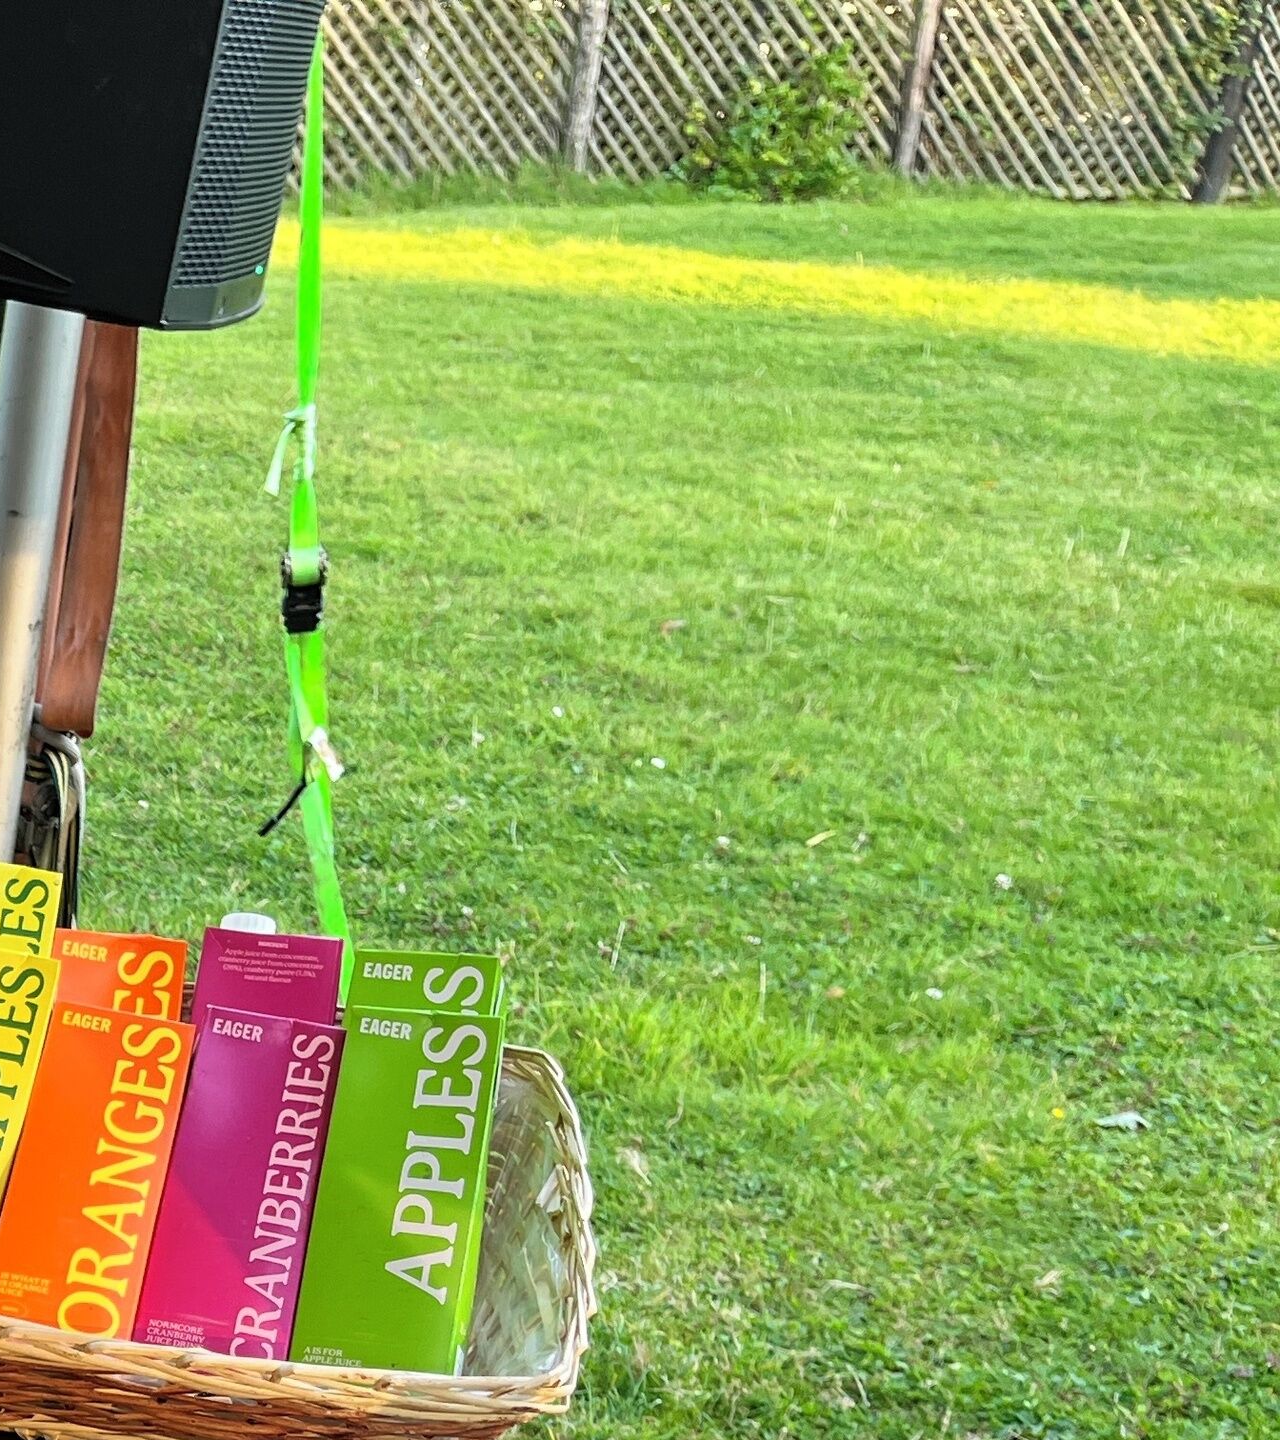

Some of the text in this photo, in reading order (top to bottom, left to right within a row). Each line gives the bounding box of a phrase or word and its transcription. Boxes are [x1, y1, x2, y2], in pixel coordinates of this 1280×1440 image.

[61, 940, 108, 962] EAGER
[363, 962, 413, 981] EAGER
[62, 1011, 112, 1033] EAGER
[212, 1017, 264, 1042] EAGER
[359, 1017, 413, 1040] EAGER
[385, 1024, 488, 1306] APPLES
[57, 1024, 182, 1340] ORANGES
[229, 1034, 336, 1360] CRANBERRIES
[146, 1327, 206, 1344] CRANBERRY
[148, 1318, 204, 1336] NORMCORE
[144, 1335, 172, 1347] JUICE
[304, 1346, 343, 1357] A IS FOR
[302, 1354, 335, 1365] APPLE
